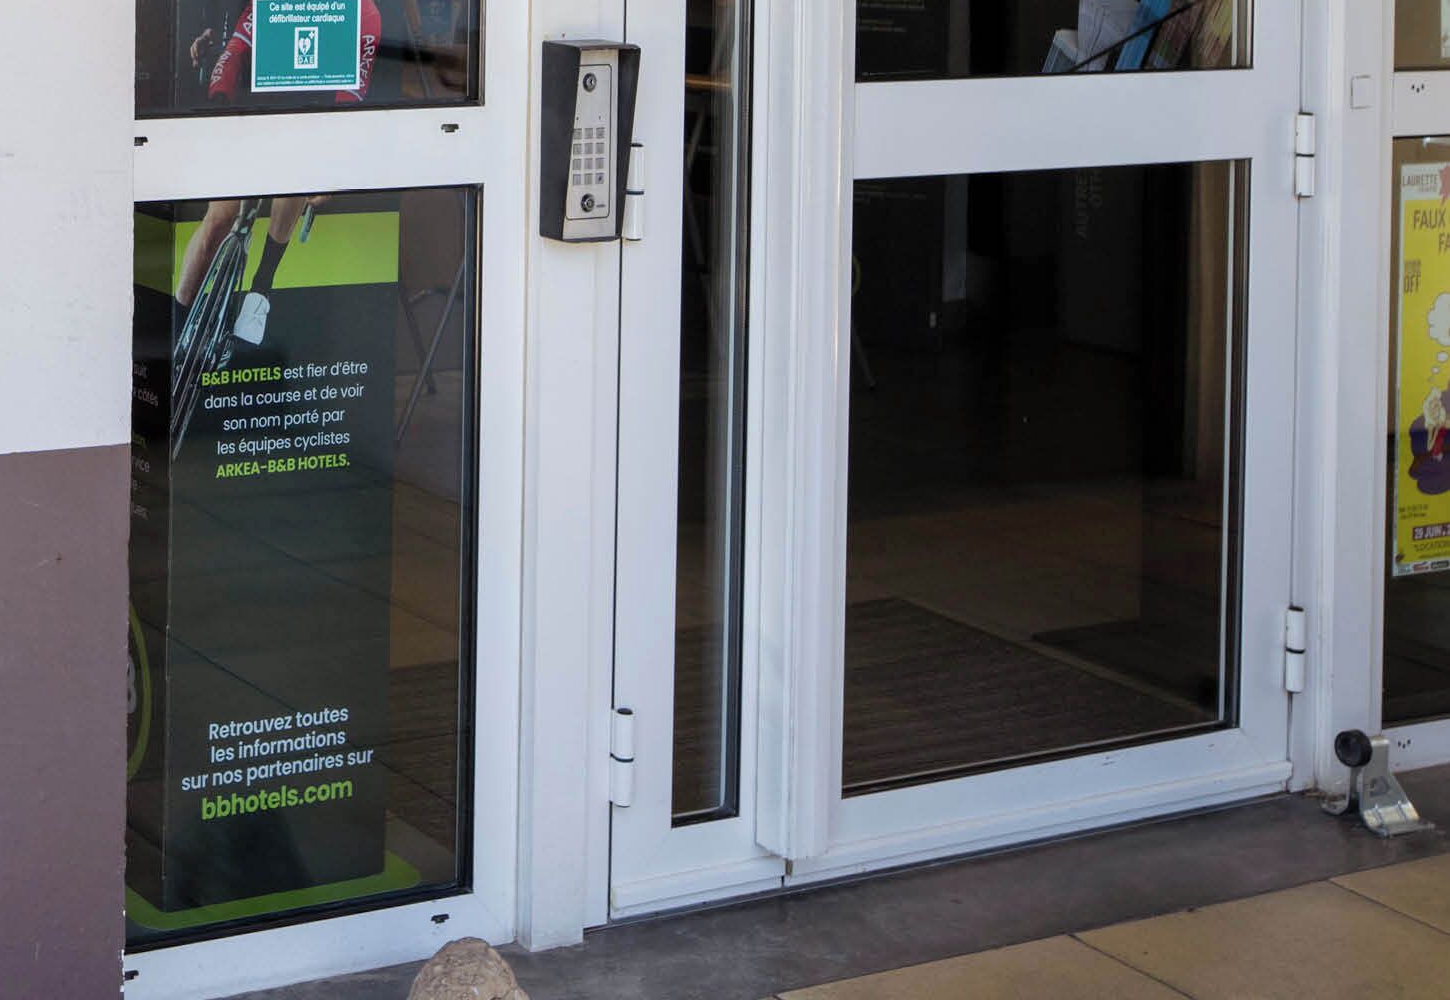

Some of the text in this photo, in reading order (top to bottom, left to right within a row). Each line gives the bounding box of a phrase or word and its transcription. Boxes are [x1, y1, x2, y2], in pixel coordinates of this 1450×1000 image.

[269, 14, 345, 23] défibrillateur cardiaque
[270, 2, 279, 11] Ce
[281, 2, 293, 10] site
[307, 2, 329, 11] équipé
[331, 2, 345, 10] d'un
[1413, 209, 1446, 230] FAUX
[202, 362, 368, 386] B&B HOTELS est fier d'être
[204, 384, 364, 409] dans la course et de voir
[216, 454, 350, 479] ARKEA-B&B HOTELS.
[209, 707, 349, 740] Retrouvez toutes
[182, 748, 373, 791] sur nos partenaires sur
[202, 780, 353, 820] bbhotels.com
